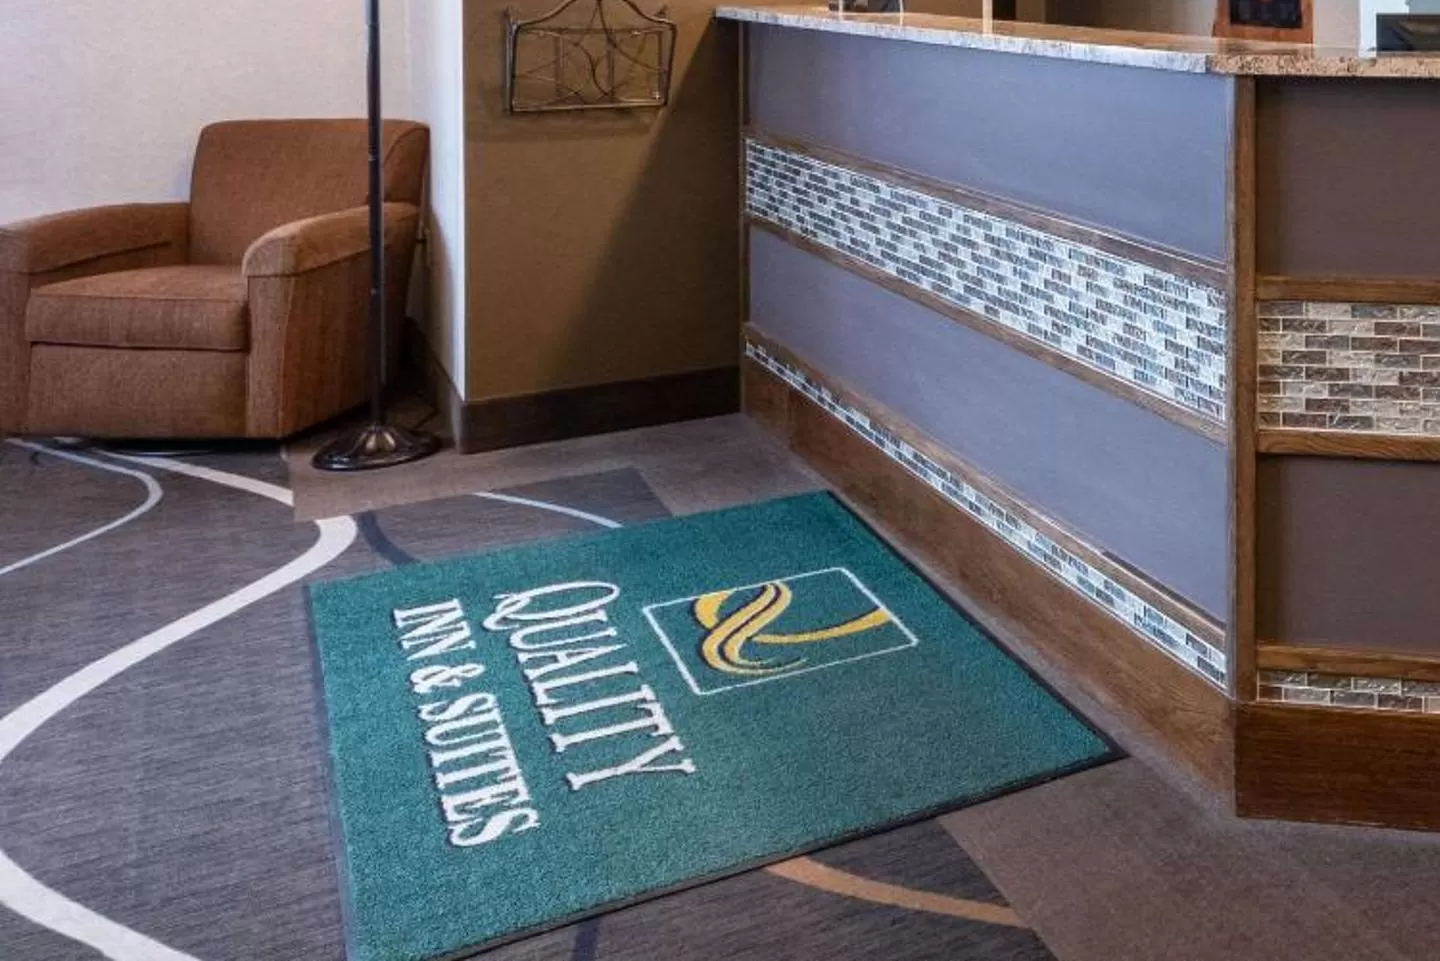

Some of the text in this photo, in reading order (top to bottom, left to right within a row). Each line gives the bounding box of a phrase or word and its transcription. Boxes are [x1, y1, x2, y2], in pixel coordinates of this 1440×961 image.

[393, 598, 540, 847] INN & SUITES
[482, 580, 697, 791] QUALITY
